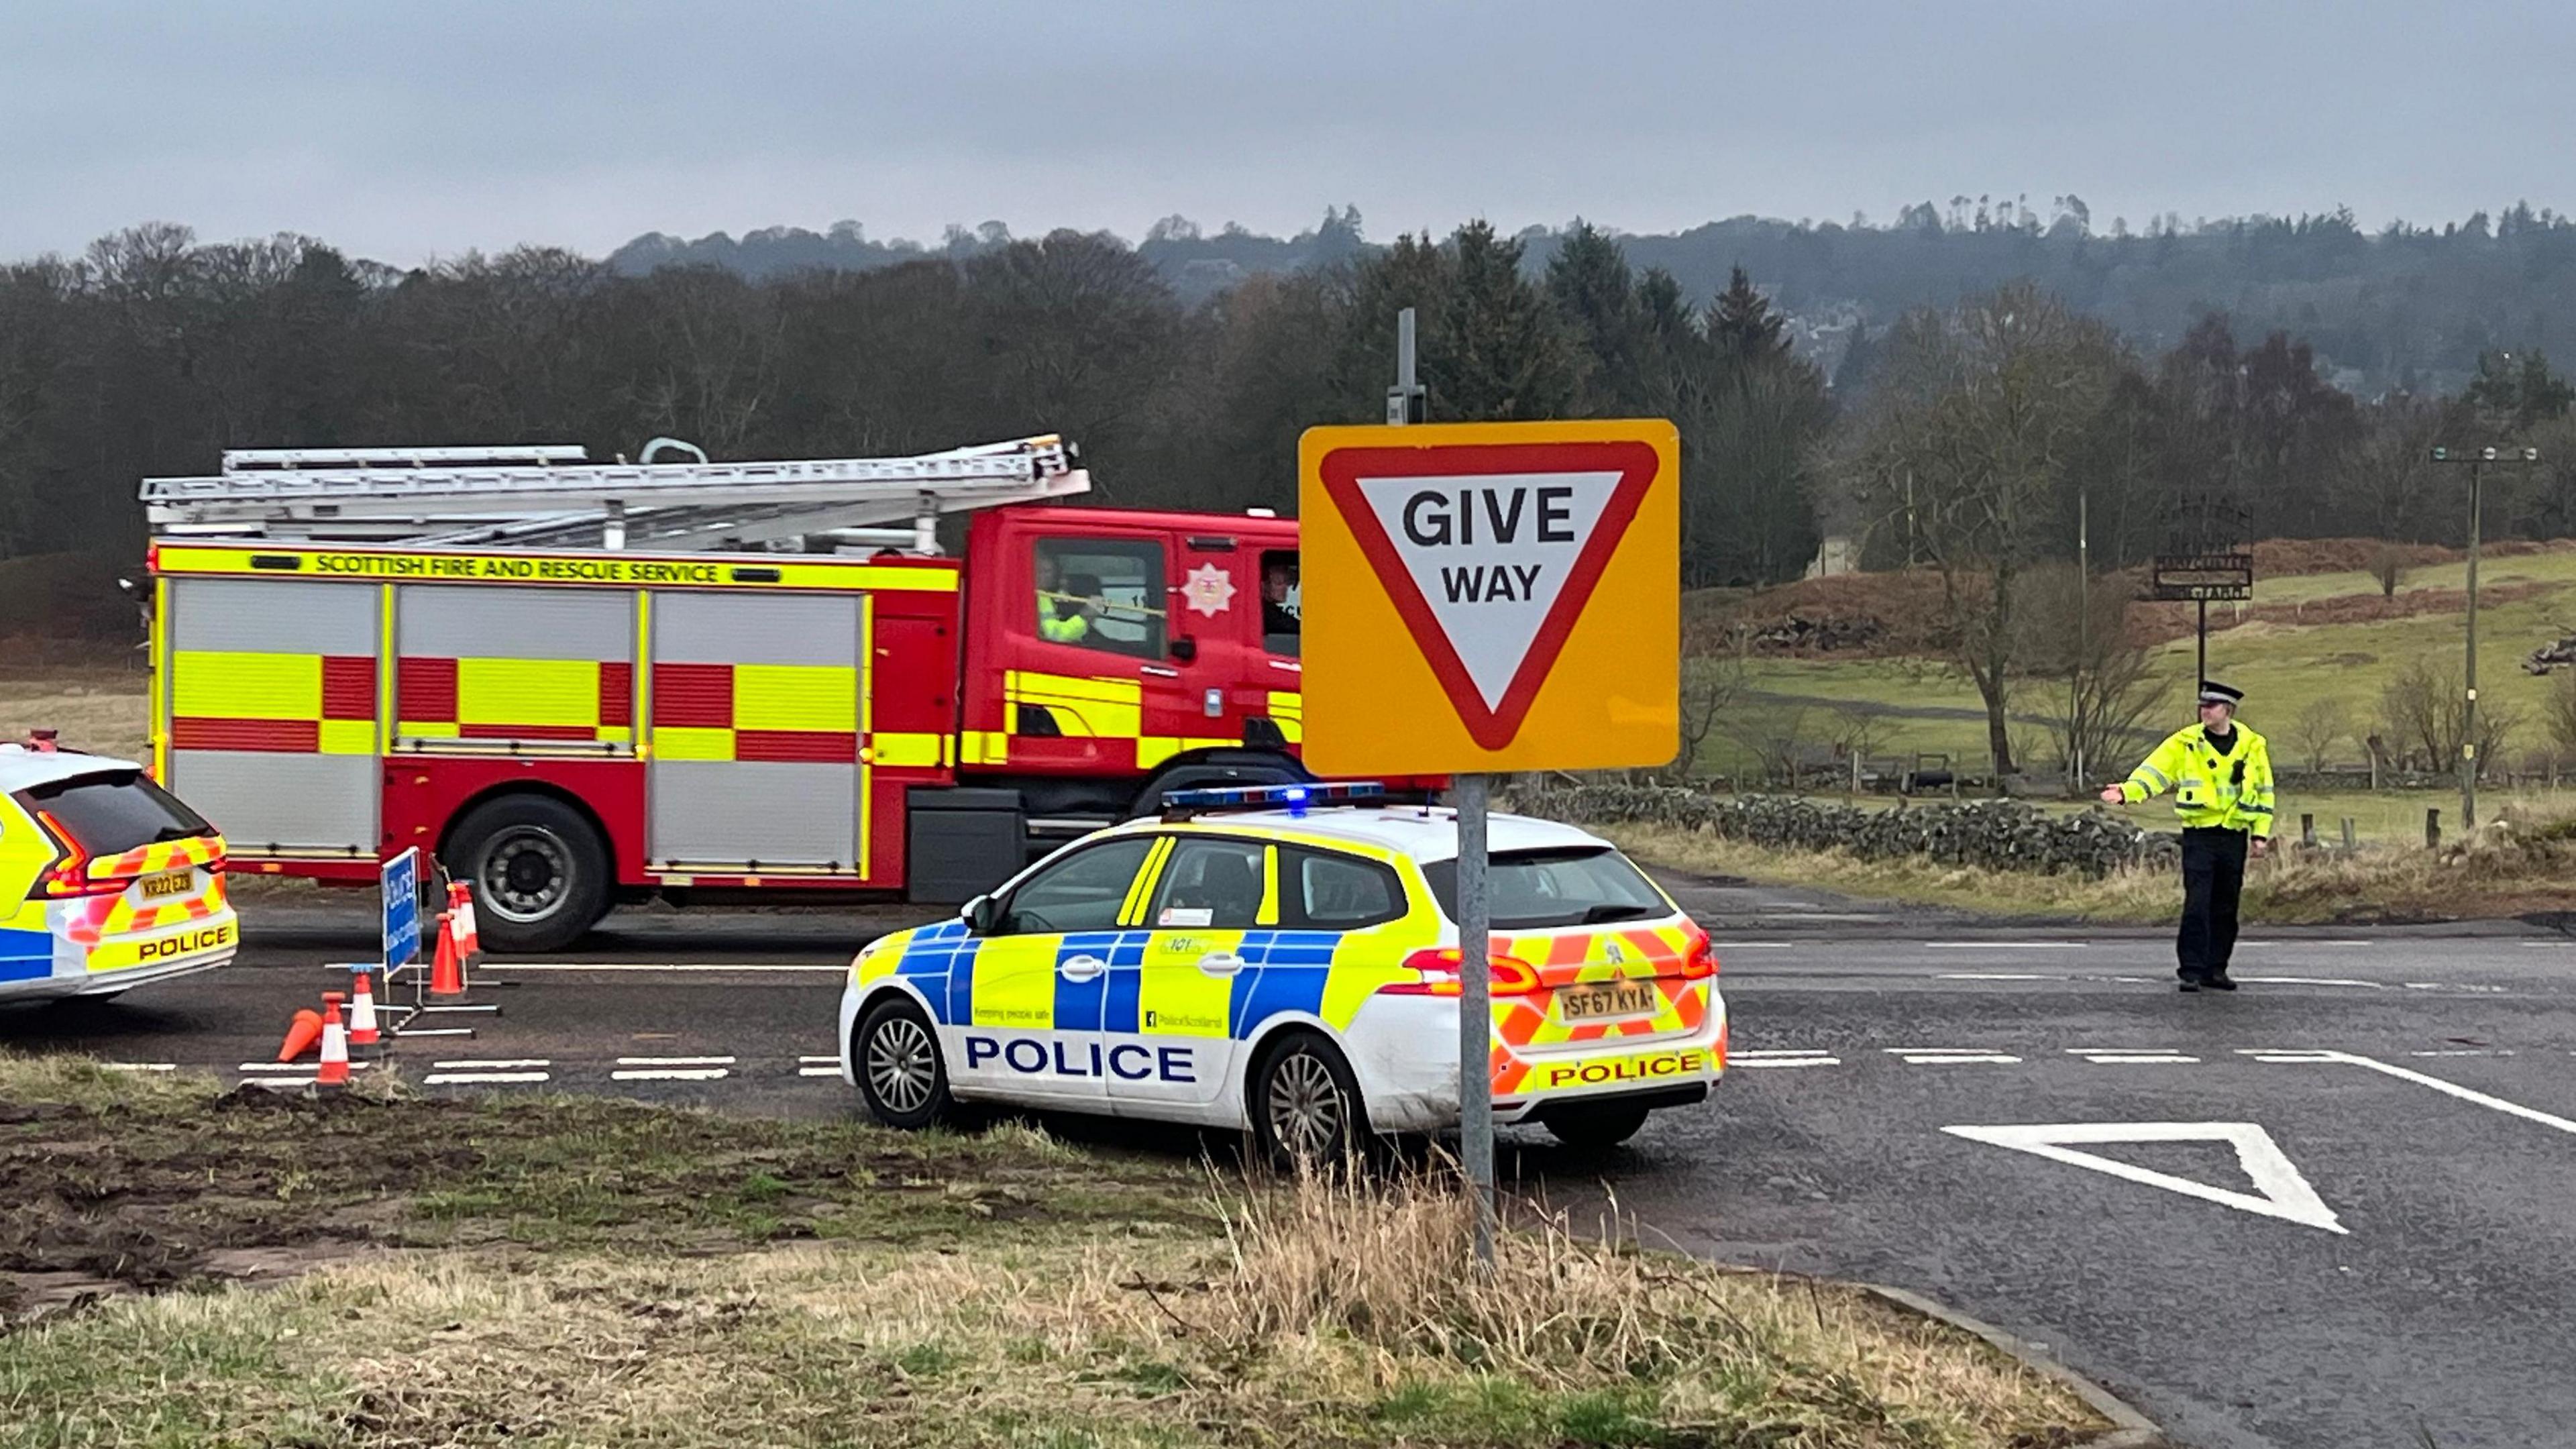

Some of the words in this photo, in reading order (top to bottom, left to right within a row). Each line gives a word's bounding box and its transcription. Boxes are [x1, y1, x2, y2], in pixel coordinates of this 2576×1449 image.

[1403, 486, 1575, 547] GIVE
[316, 554, 427, 575] SCOTTISH
[431, 558, 477, 576] FIRE
[483, 560, 533, 578] AND
[539, 561, 623, 580] RESCUE
[631, 564, 718, 582] SERVICE
[1441, 564, 1542, 603] WAY
[139, 926, 229, 961] POLICE
[1170, 938, 1192, 952] 101
[1569, 991, 1613, 1016] SF67
[1616, 988, 1649, 1012] KYA
[965, 1036, 1197, 1083] POLICE
[1550, 1053, 1703, 1087] POLICE
